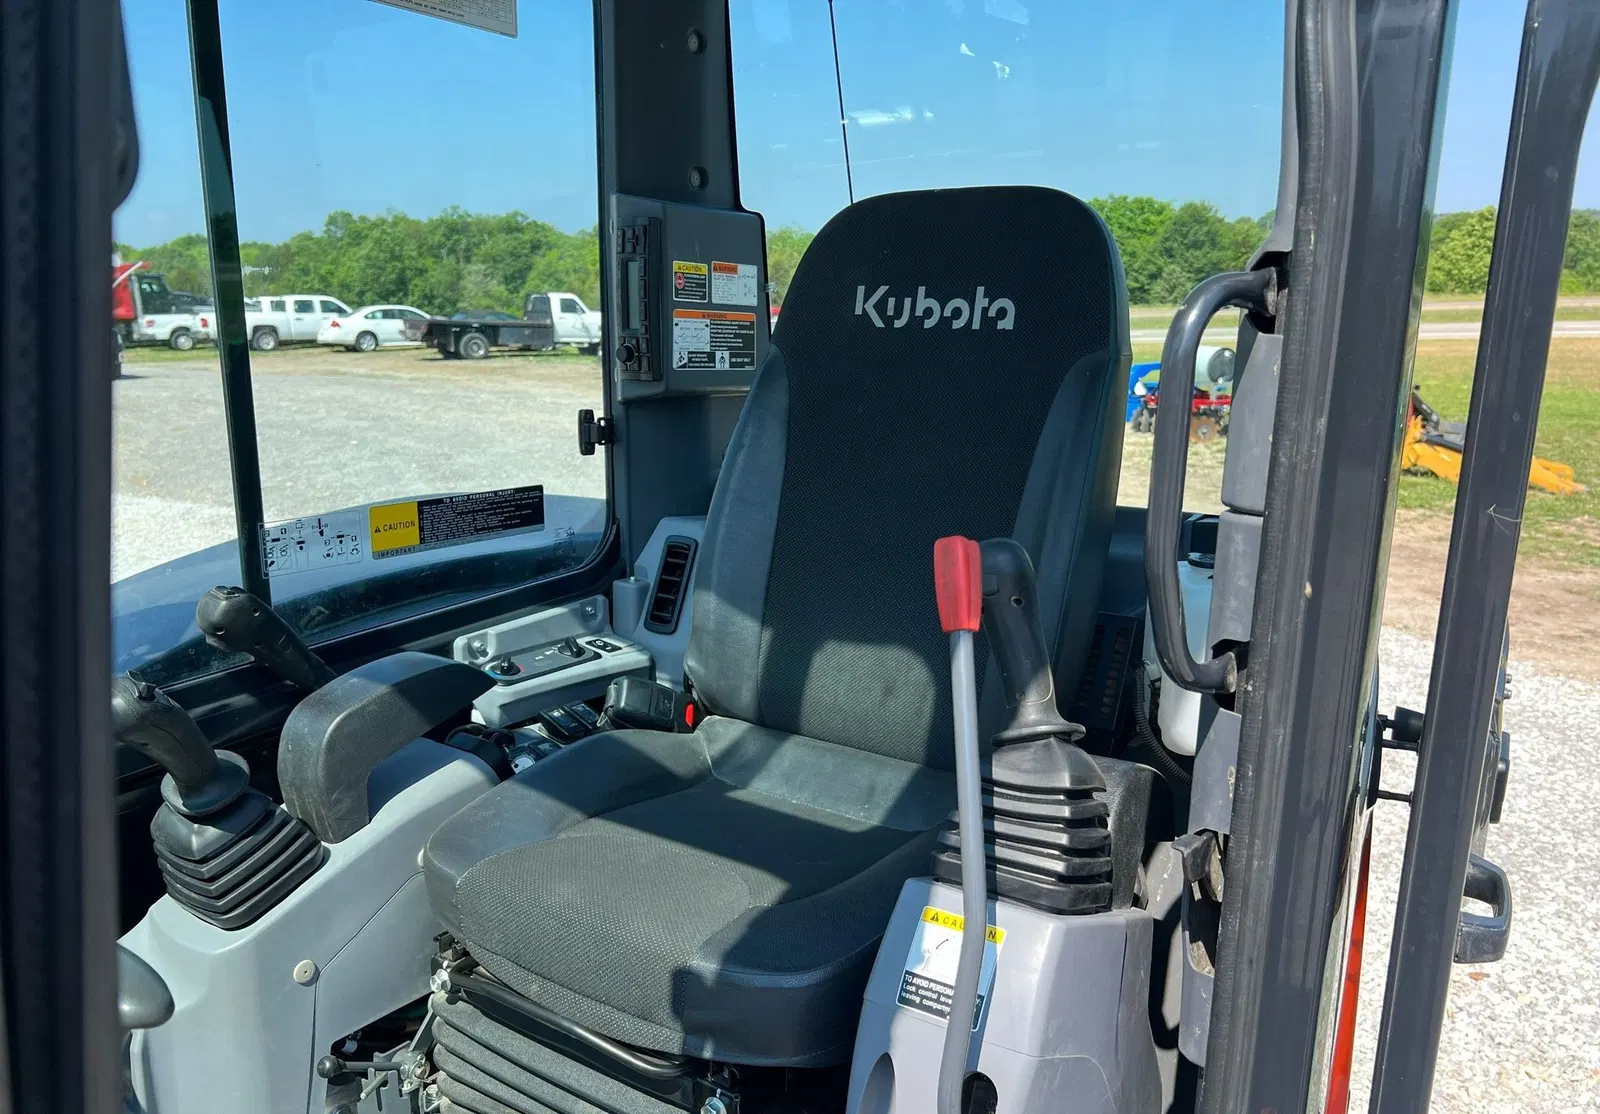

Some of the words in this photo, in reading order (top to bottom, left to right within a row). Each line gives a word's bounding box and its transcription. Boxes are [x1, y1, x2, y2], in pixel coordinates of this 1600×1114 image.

[854, 285, 1016, 330] Kubota
[470, 492, 495, 500] PERSONAL
[382, 520, 416, 532] CAUTION
[378, 546, 416, 558] IMPORTANT
[904, 974, 912, 982] TO
[912, 976, 929, 988] AVOID
[901, 991, 920, 1004] leaving
[903, 983, 916, 992] Lock
[918, 988, 938, 1000] control
[940, 994, 952, 1004] leve
